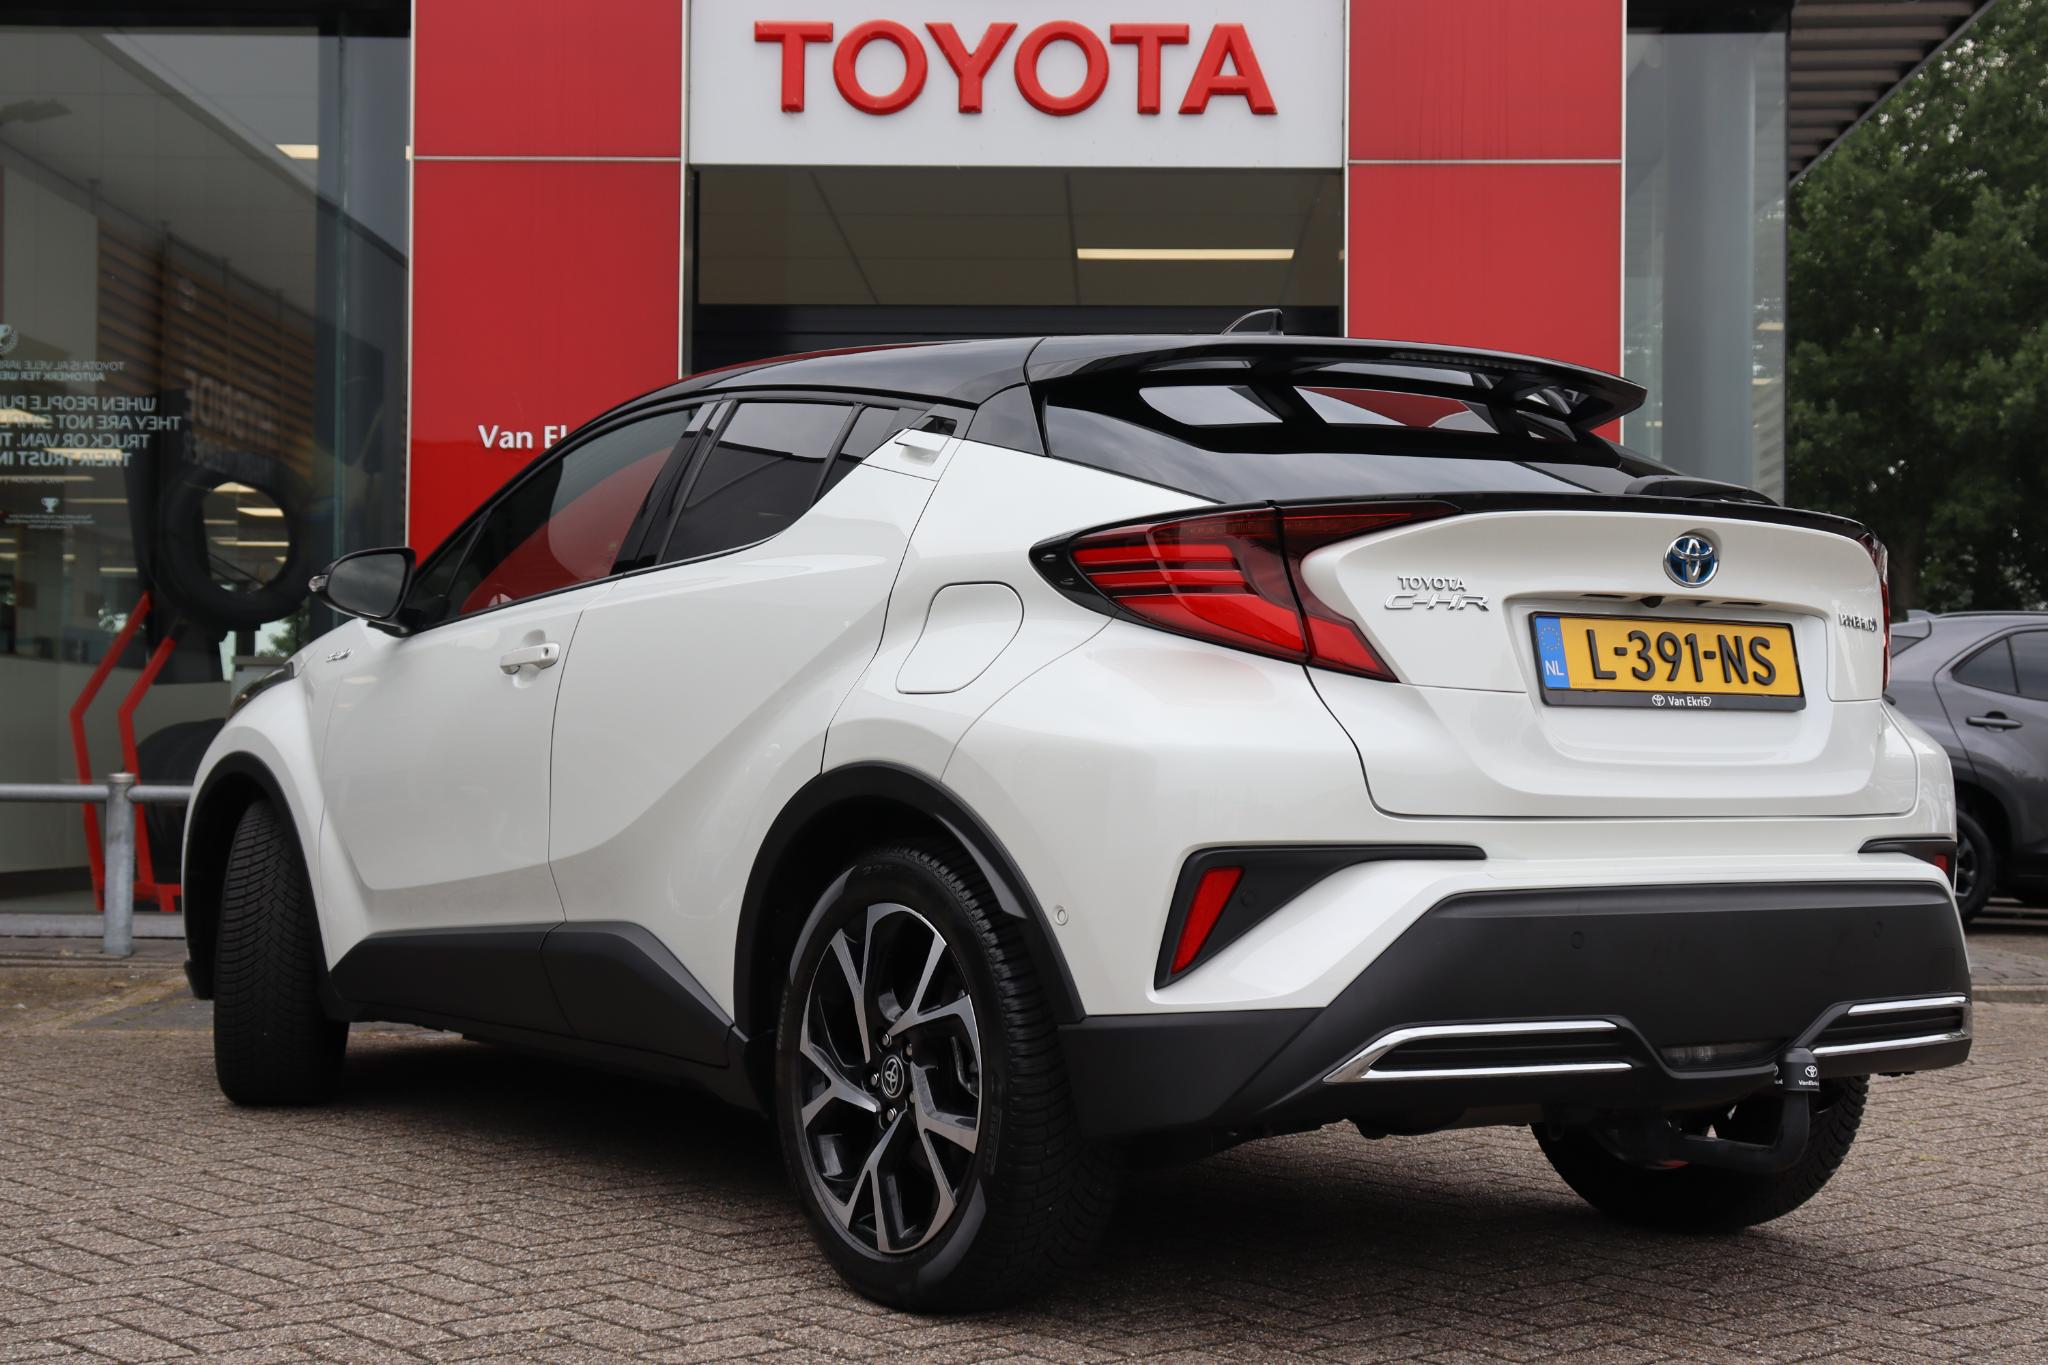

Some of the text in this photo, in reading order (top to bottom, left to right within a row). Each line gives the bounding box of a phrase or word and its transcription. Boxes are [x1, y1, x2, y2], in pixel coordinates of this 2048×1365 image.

[754, 20, 1278, 117] TOYOTA
[478, 424, 533, 449] Van
[1397, 575, 1467, 592] TOYOTA
[1383, 593, 1490, 612] C-HR
[1545, 629, 1777, 686] NL L-391-NS
[1667, 695, 1708, 707] Van Ekris
